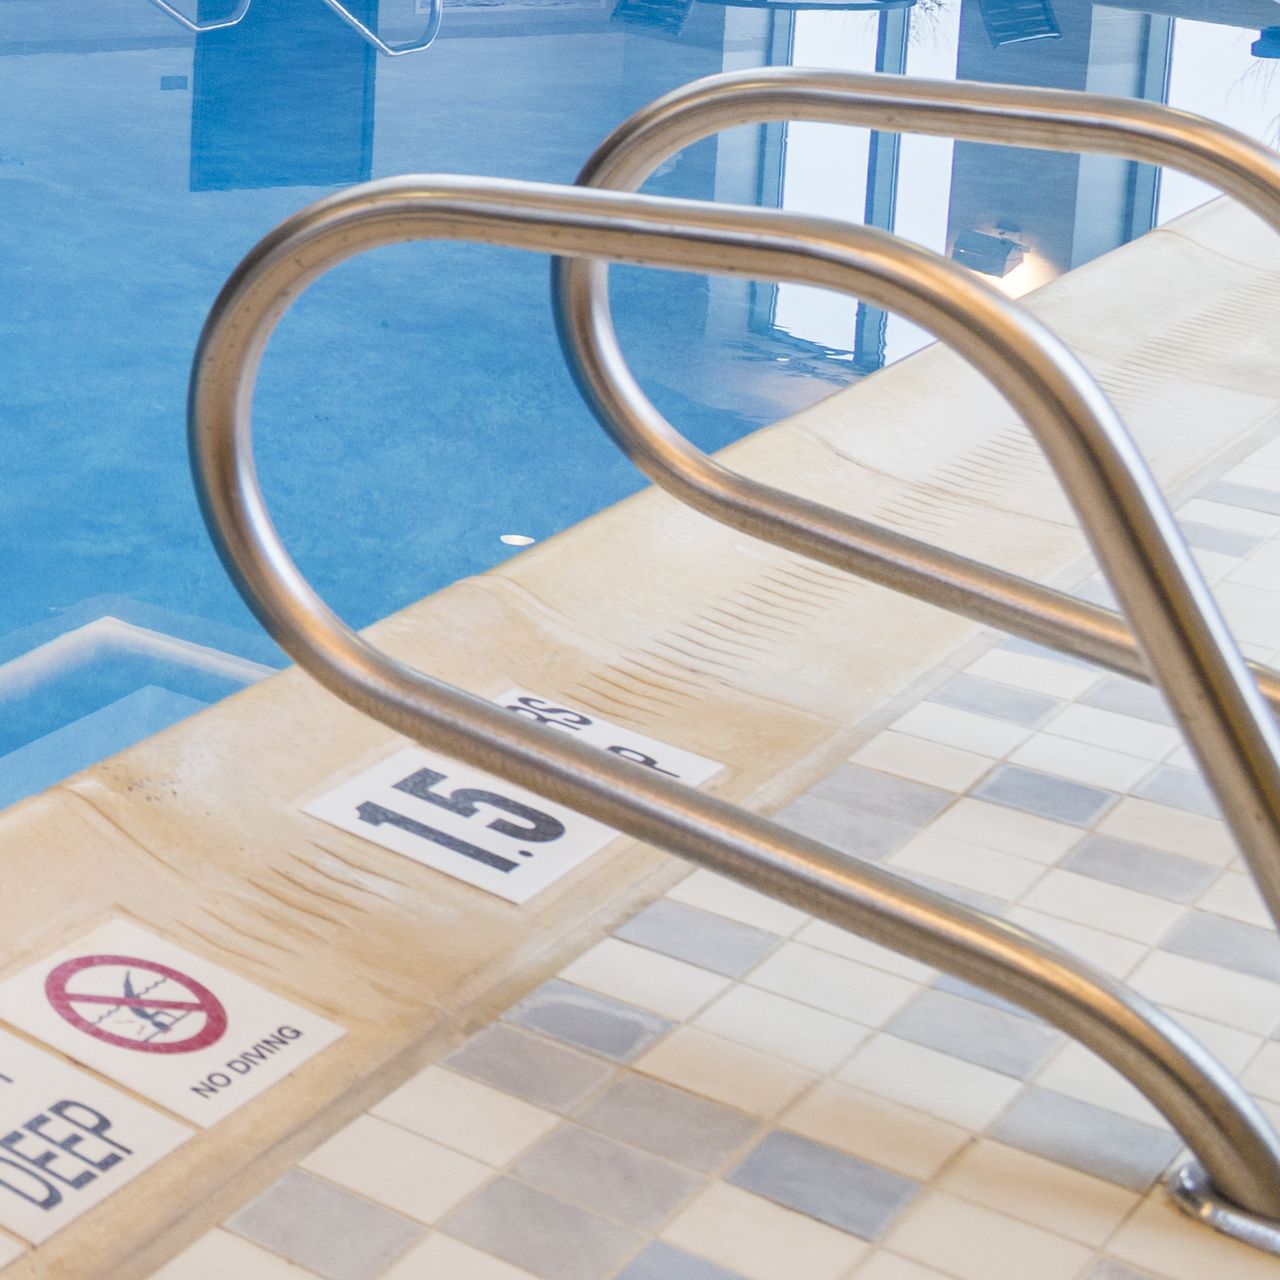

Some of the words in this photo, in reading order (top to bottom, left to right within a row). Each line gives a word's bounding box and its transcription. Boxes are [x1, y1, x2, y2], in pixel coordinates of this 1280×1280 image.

[356, 767, 567, 874] 1.5
[191, 1071, 233, 1100] NO
[233, 1024, 304, 1075] DIVING
